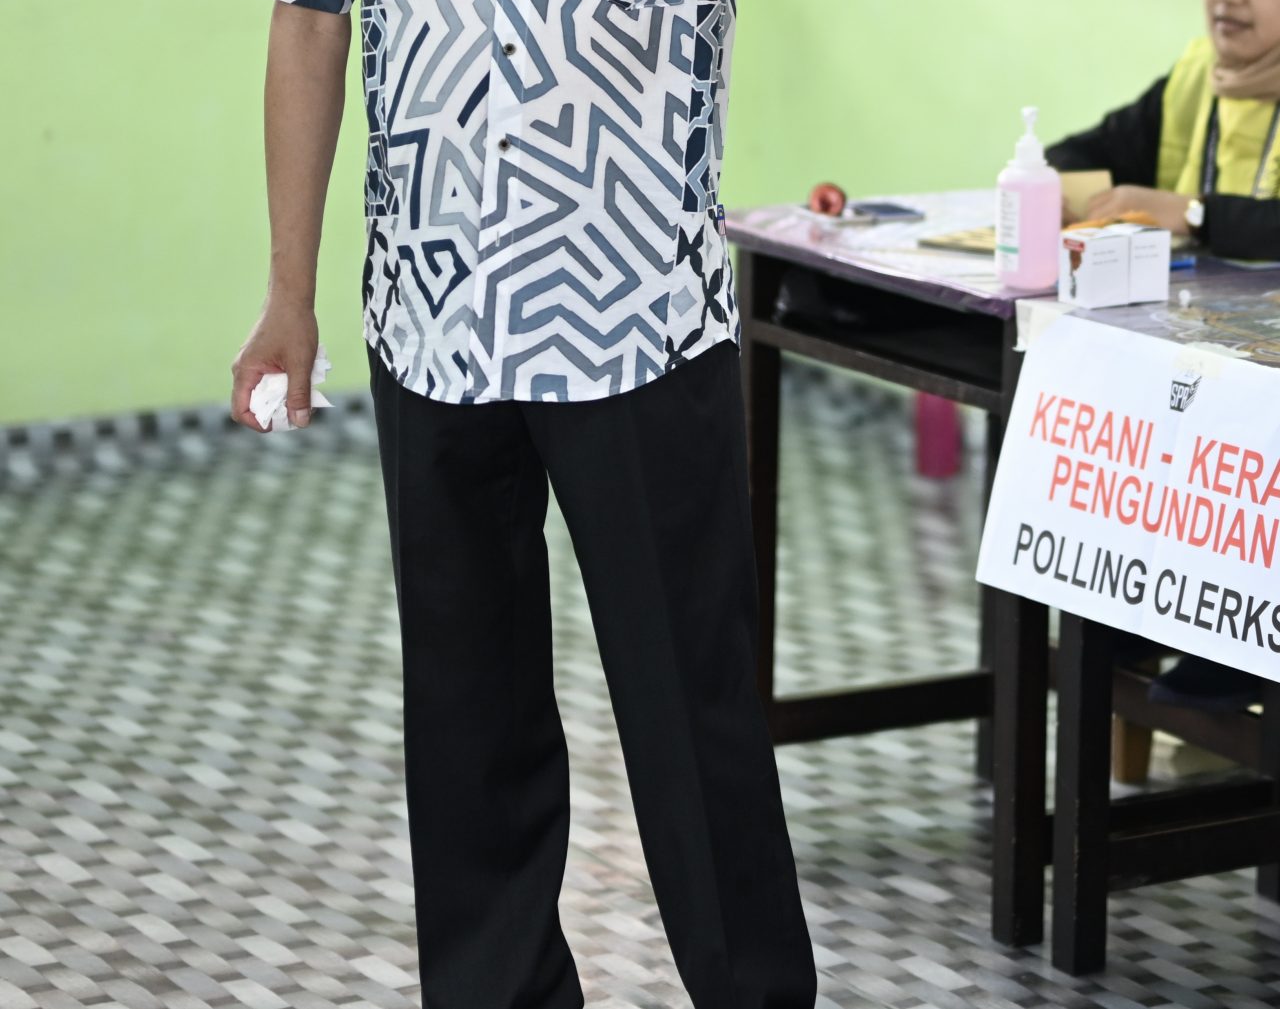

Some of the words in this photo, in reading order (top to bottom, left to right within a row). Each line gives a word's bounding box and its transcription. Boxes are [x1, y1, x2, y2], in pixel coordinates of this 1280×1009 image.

[1030, 391, 1154, 470] KERANI
[1161, 453, 1173, 464] -
[1170, 382, 1190, 410] SPR
[1048, 455, 1280, 569] PENGUNDIAN
[1013, 523, 1147, 605] POLLING
